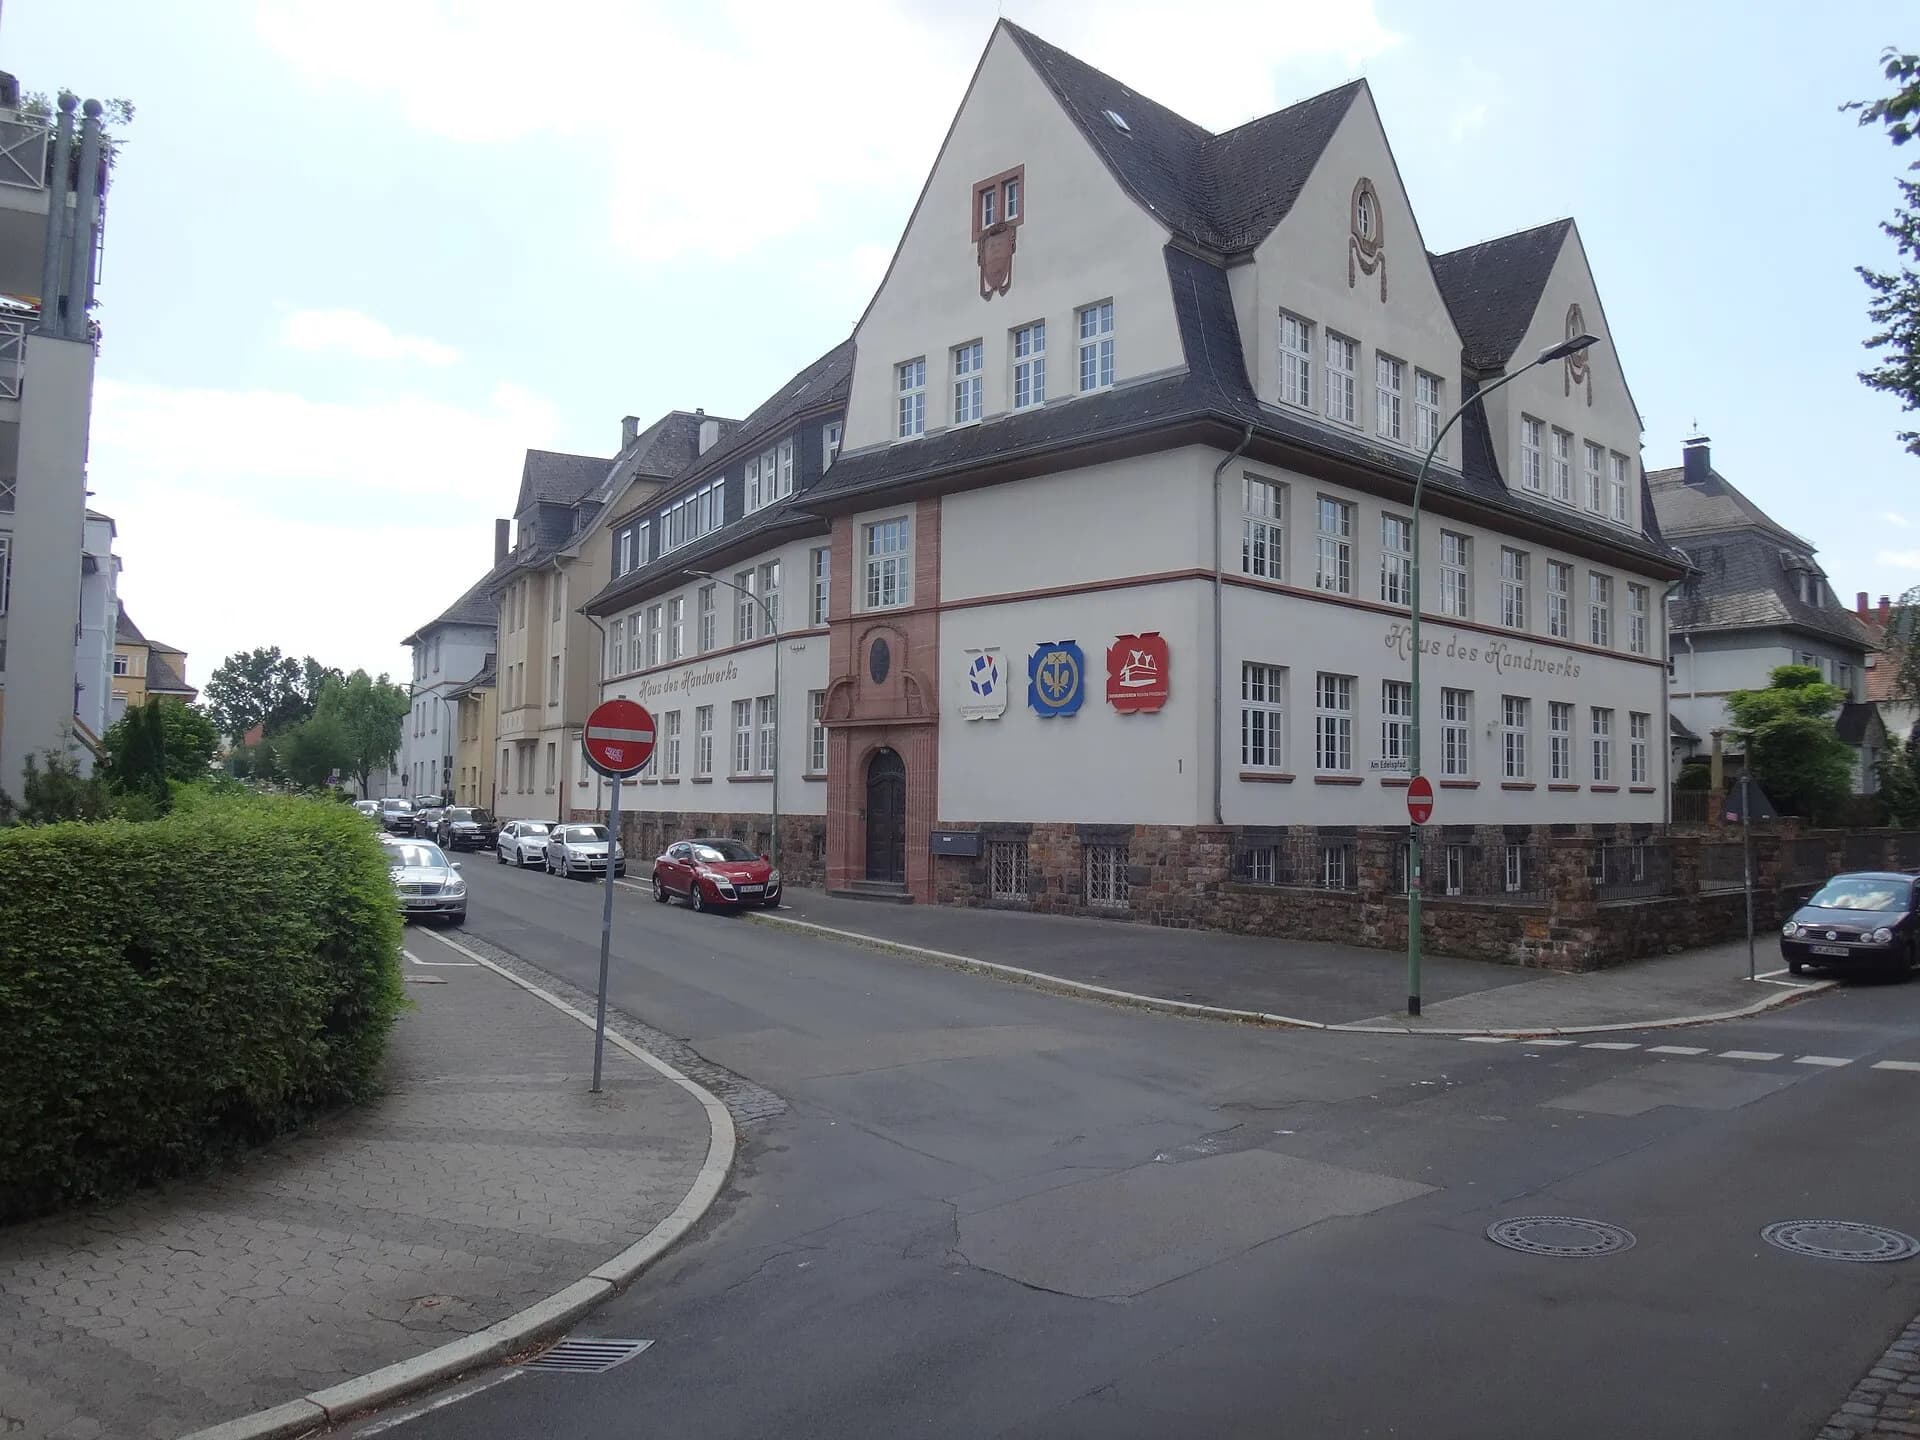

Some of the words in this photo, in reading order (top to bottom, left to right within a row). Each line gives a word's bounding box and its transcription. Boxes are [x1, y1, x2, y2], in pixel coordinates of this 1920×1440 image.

[1446, 633, 1479, 661] des
[1485, 640, 1581, 678] Handwerks
[639, 679, 662, 704] Haus
[663, 674, 679, 693] des
[681, 660, 738, 696] Handwerks
[1370, 761, 1380, 769] Am
